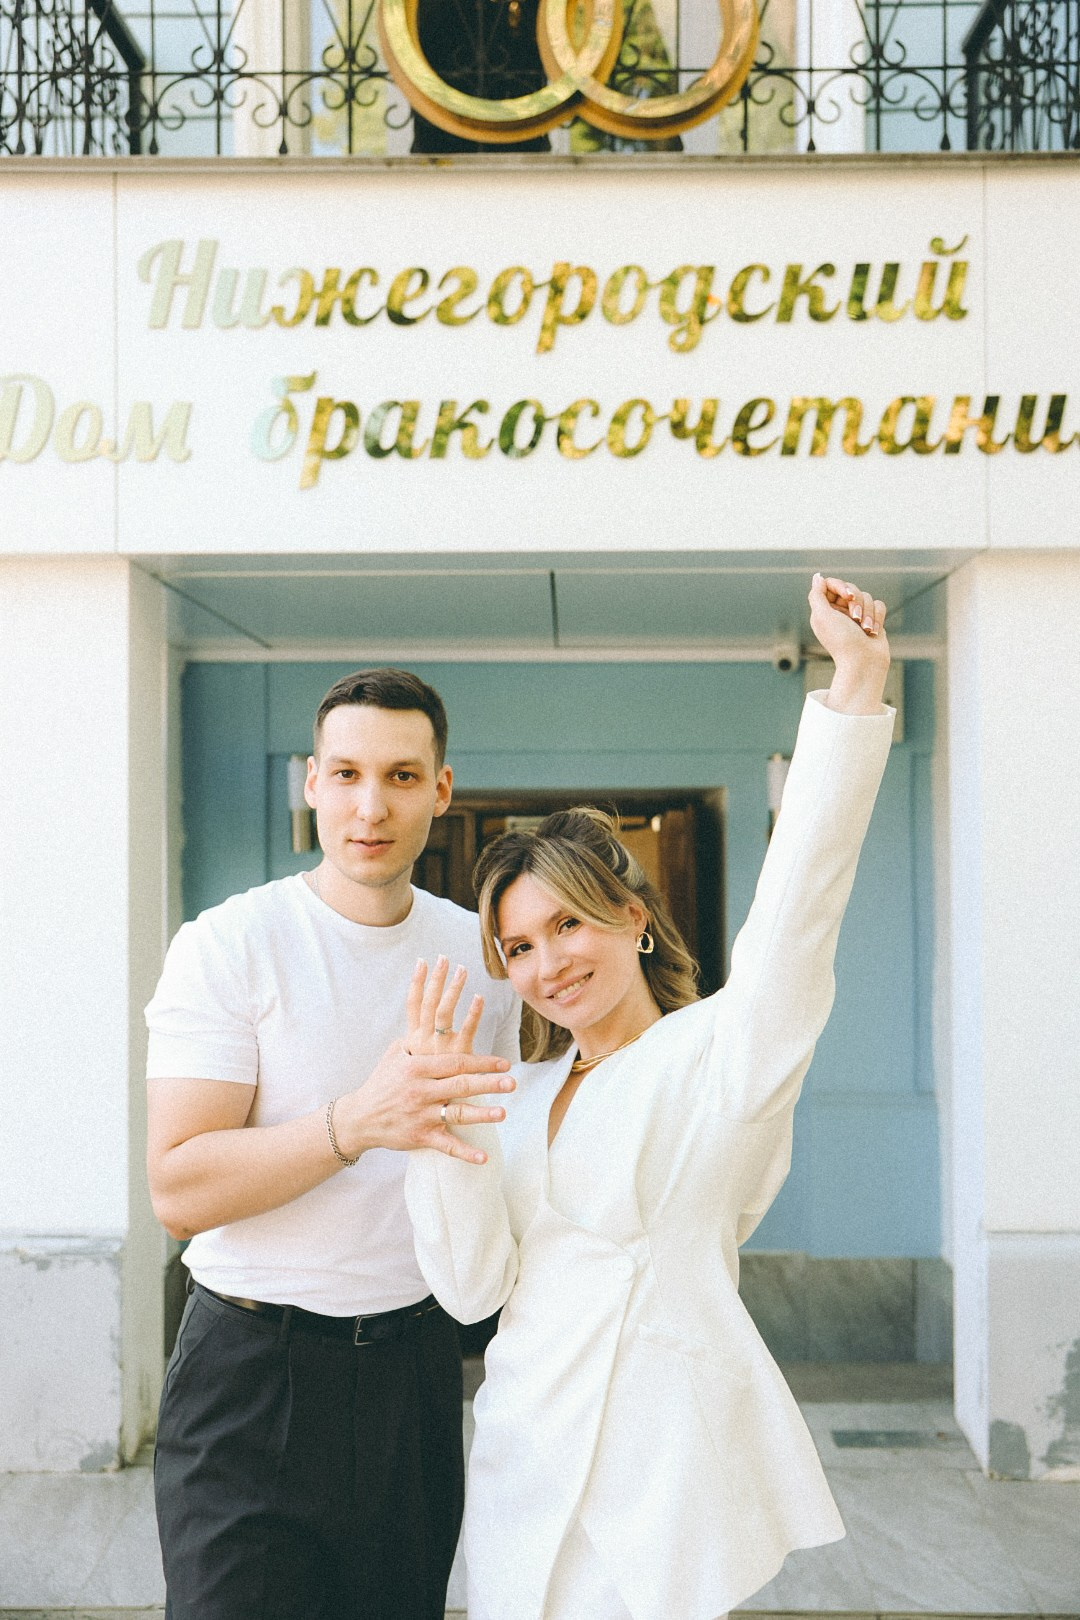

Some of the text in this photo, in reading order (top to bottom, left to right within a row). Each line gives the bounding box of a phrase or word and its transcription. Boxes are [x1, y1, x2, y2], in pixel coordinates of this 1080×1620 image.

[137, 235, 970, 354] Нижегородский
[0, 370, 1080, 491] Дом бракосочетани
